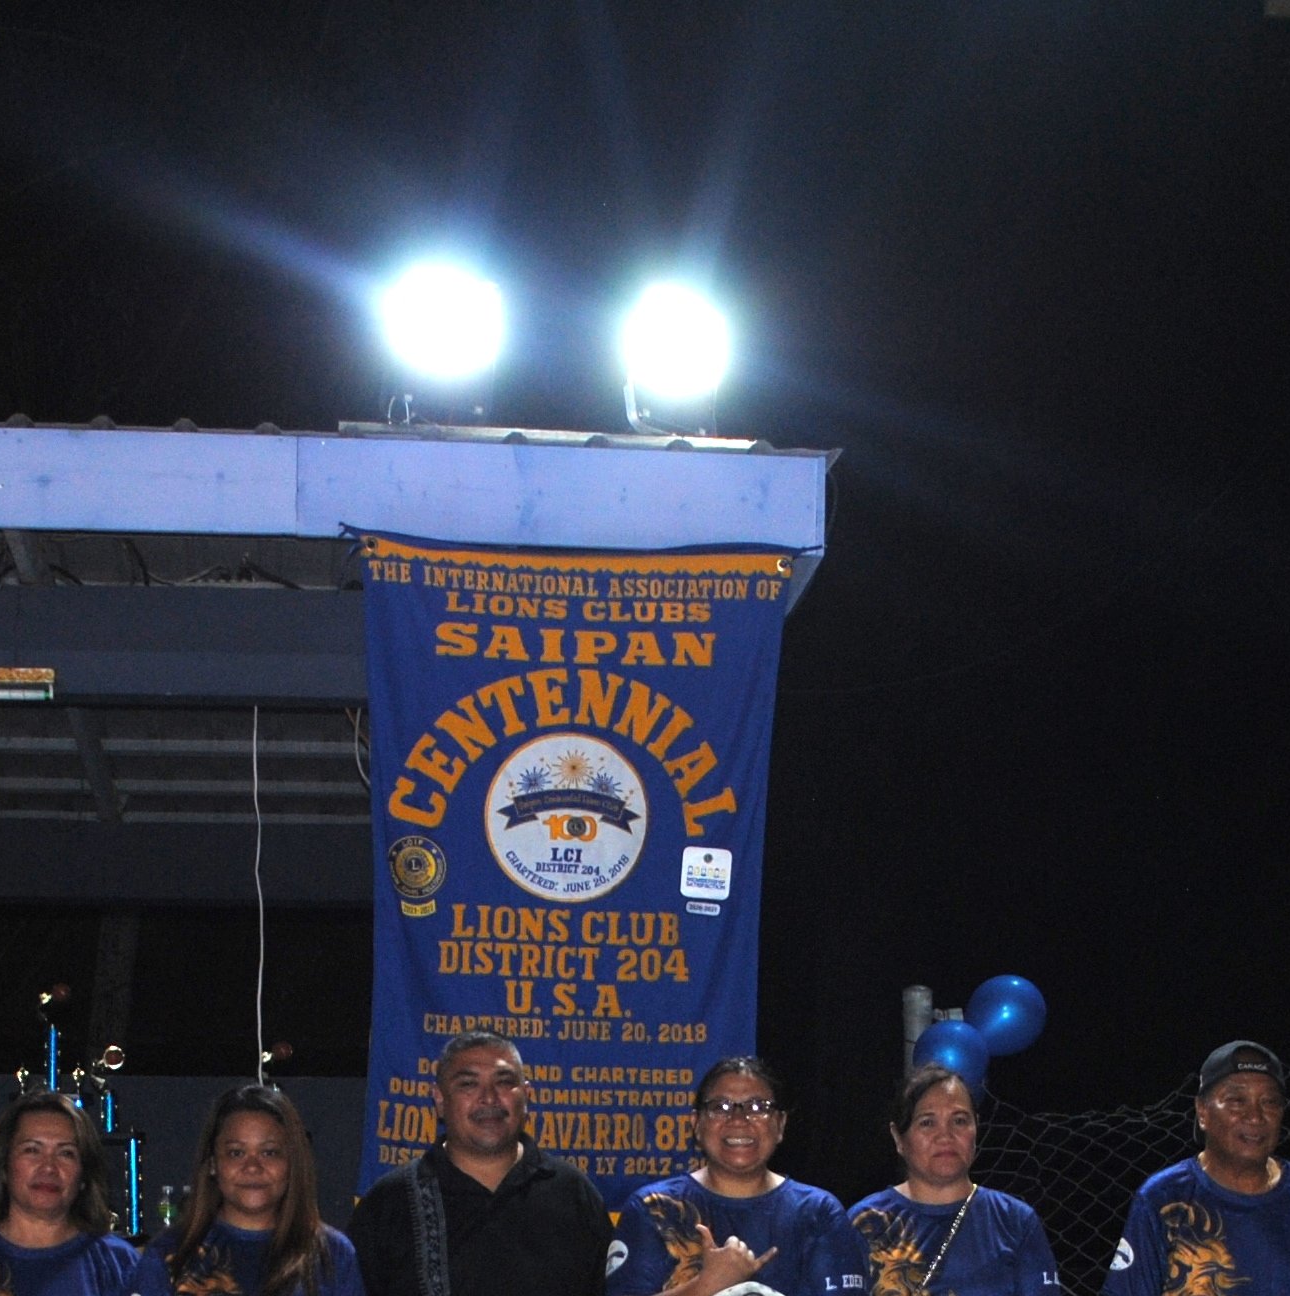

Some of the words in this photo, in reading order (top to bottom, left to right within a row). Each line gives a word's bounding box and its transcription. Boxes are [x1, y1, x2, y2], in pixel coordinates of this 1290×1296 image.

[369, 561, 411, 583] THE
[423, 565, 598, 597] INTERNATIONAL
[608, 578, 749, 600] ASSOCIATION
[756, 580, 782, 600] OF
[446, 591, 568, 620] LIONS
[582, 600, 711, 623] CLUBS
[435, 621, 716, 666] SAIPAN
[389, 668, 737, 837] CENTENNIAL
[535, 862, 579, 875] DISTRICT
[581, 865, 600, 876] 204
[550, 847, 583, 863] LCI
[563, 880, 591, 893] JUNE
[609, 853, 630, 879] 2018
[451, 903, 570, 942] LIONS
[581, 911, 679, 945] CLUB
[438, 940, 600, 980] DISTRICT
[616, 948, 689, 982] 204
[558, 1020, 611, 1041] JUNE
[658, 1024, 707, 1043] 2018
[570, 1066, 693, 1085] CHARTERED
[377, 1100, 437, 1144] LION
